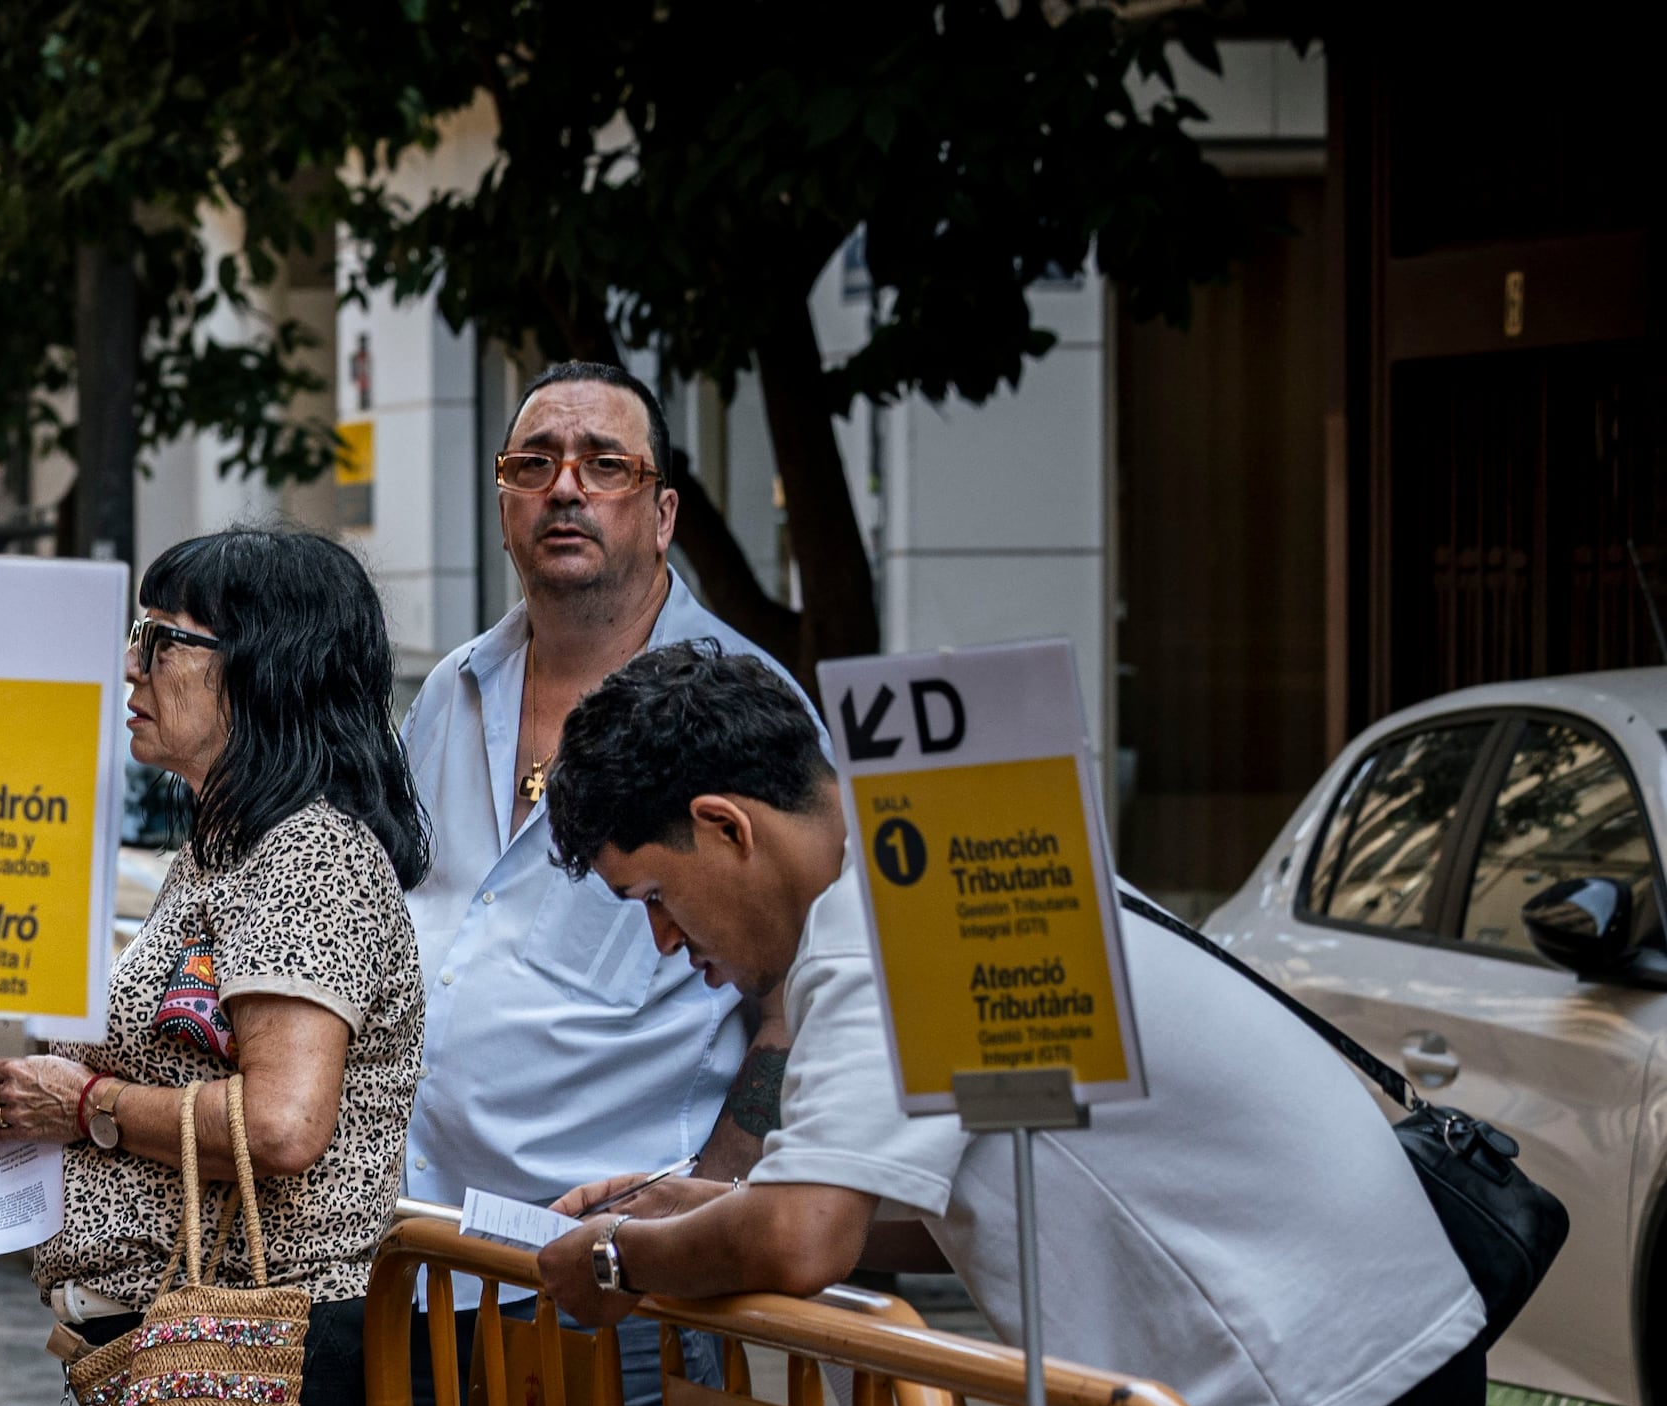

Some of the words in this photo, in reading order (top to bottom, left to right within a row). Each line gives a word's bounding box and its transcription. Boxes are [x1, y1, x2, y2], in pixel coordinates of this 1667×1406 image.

[910, 679, 966, 754] D
[873, 795, 911, 814] SALA
[21, 834, 35, 855] y
[886, 826, 909, 877] 1
[949, 830, 1058, 864] Atención
[951, 860, 1072, 895] Tributaria
[957, 897, 1009, 921] Gestión
[1014, 894, 1078, 916] Tributaria
[959, 919, 1012, 940] Integral
[24, 948, 31, 970] i
[971, 958, 1065, 992] Atenció
[974, 989, 1094, 1023] Tributària
[978, 1027, 1023, 1046] Gestió
[982, 1044, 1033, 1066] Integral
